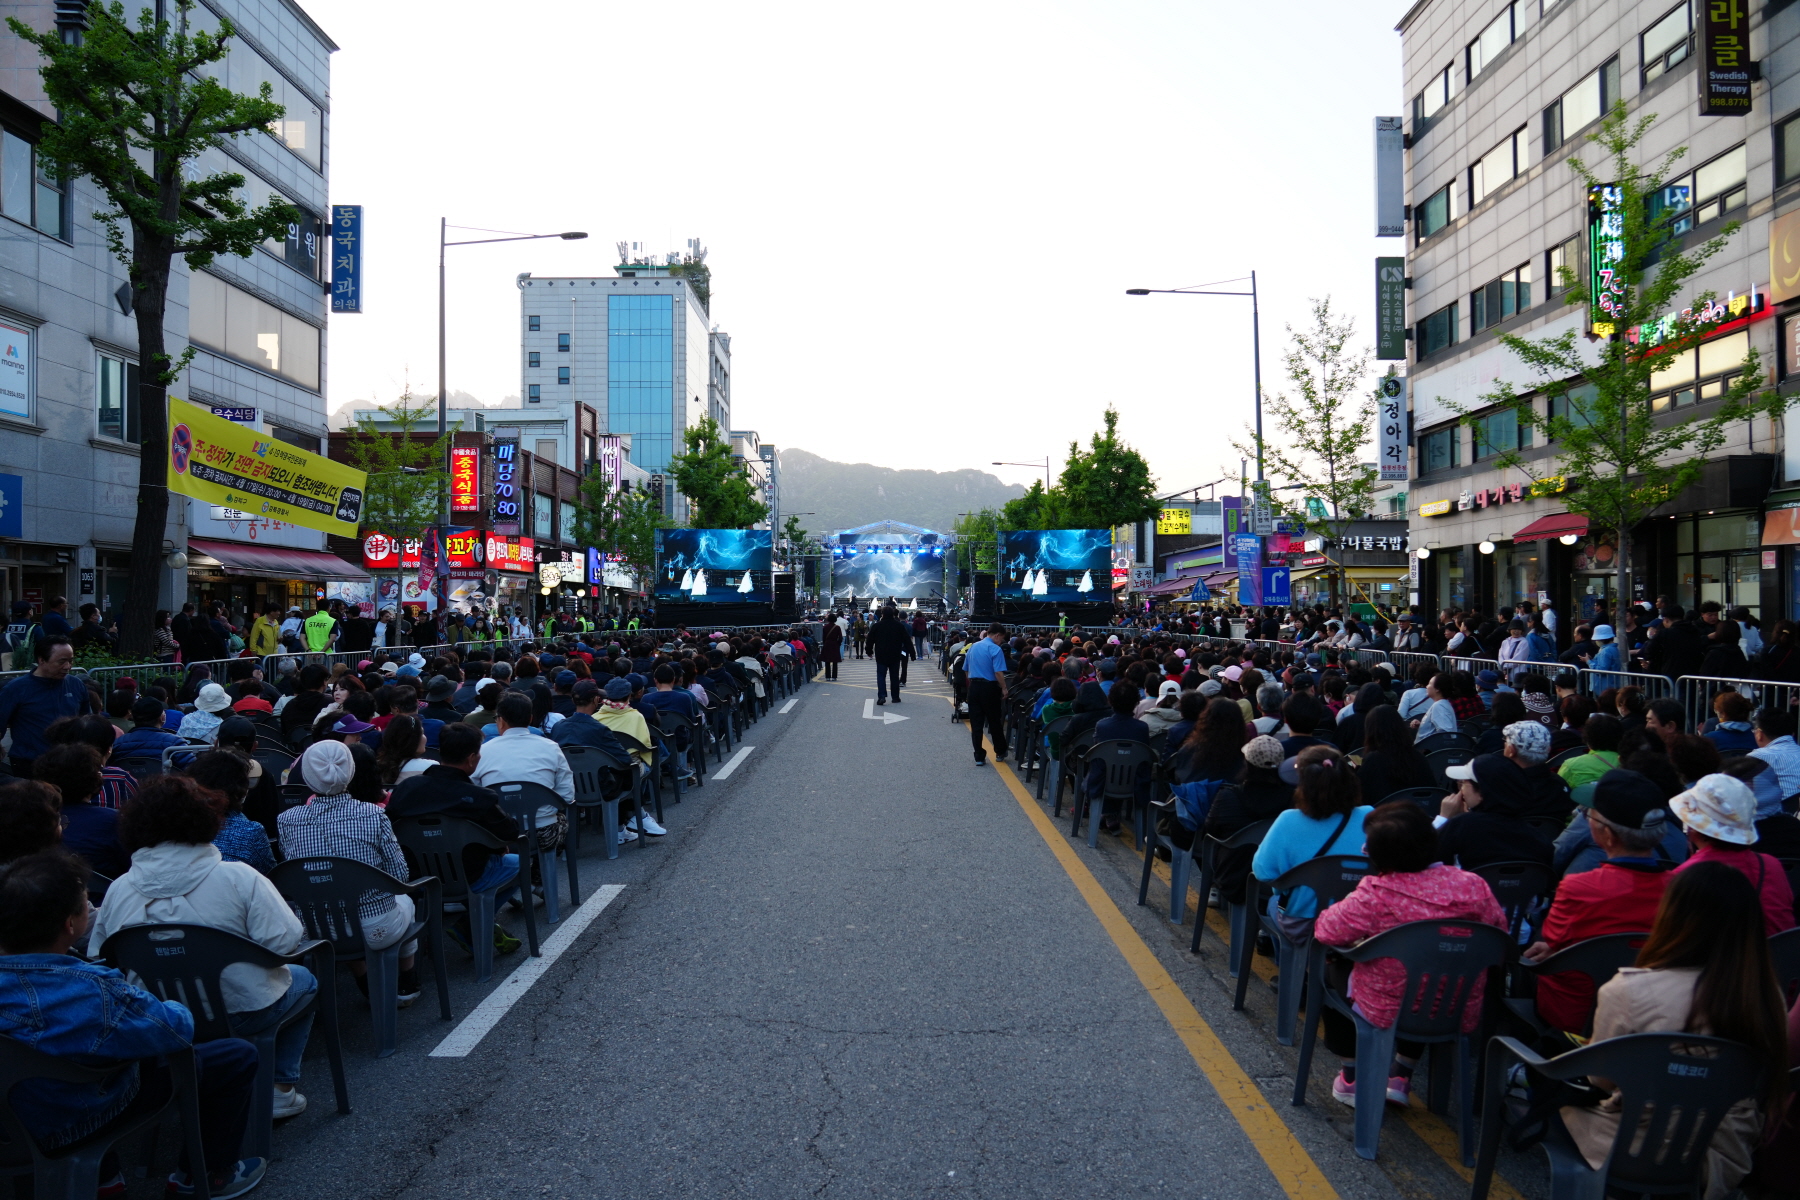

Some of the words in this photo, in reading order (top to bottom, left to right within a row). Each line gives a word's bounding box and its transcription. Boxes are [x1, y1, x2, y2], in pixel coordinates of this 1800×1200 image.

[1709, 71, 1748, 80] Swedish
[1710, 84, 1748, 94] Therapy
[1710, 98, 1749, 106] 998.8776
[335, 207, 357, 297] 동국치과
[333, 299, 356, 310] 의원
[1732, 299, 1743, 310] B1
[1, 359, 24, 370] manna
[1385, 402, 1402, 462] 정아각
[233, 454, 256, 474] 전면
[250, 460, 296, 487] 금지되오니
[292, 473, 339, 501] 협조바랍니다.
[455, 456, 474, 504] 중국식품
[265, 487, 282, 499] 20:00
[315, 502, 331, 513] 04:00
[1475, 482, 1523, 509] 대가원
[368, 537, 386, 559] 串
[81, 572, 94, 581] 1063
[1133, 579, 1152, 588] 노래방
[308, 621, 328, 629] STAFF
[155, 945, 186, 956] 렌탈코디
[1667, 1062, 1709, 1078] 렌탈코디
